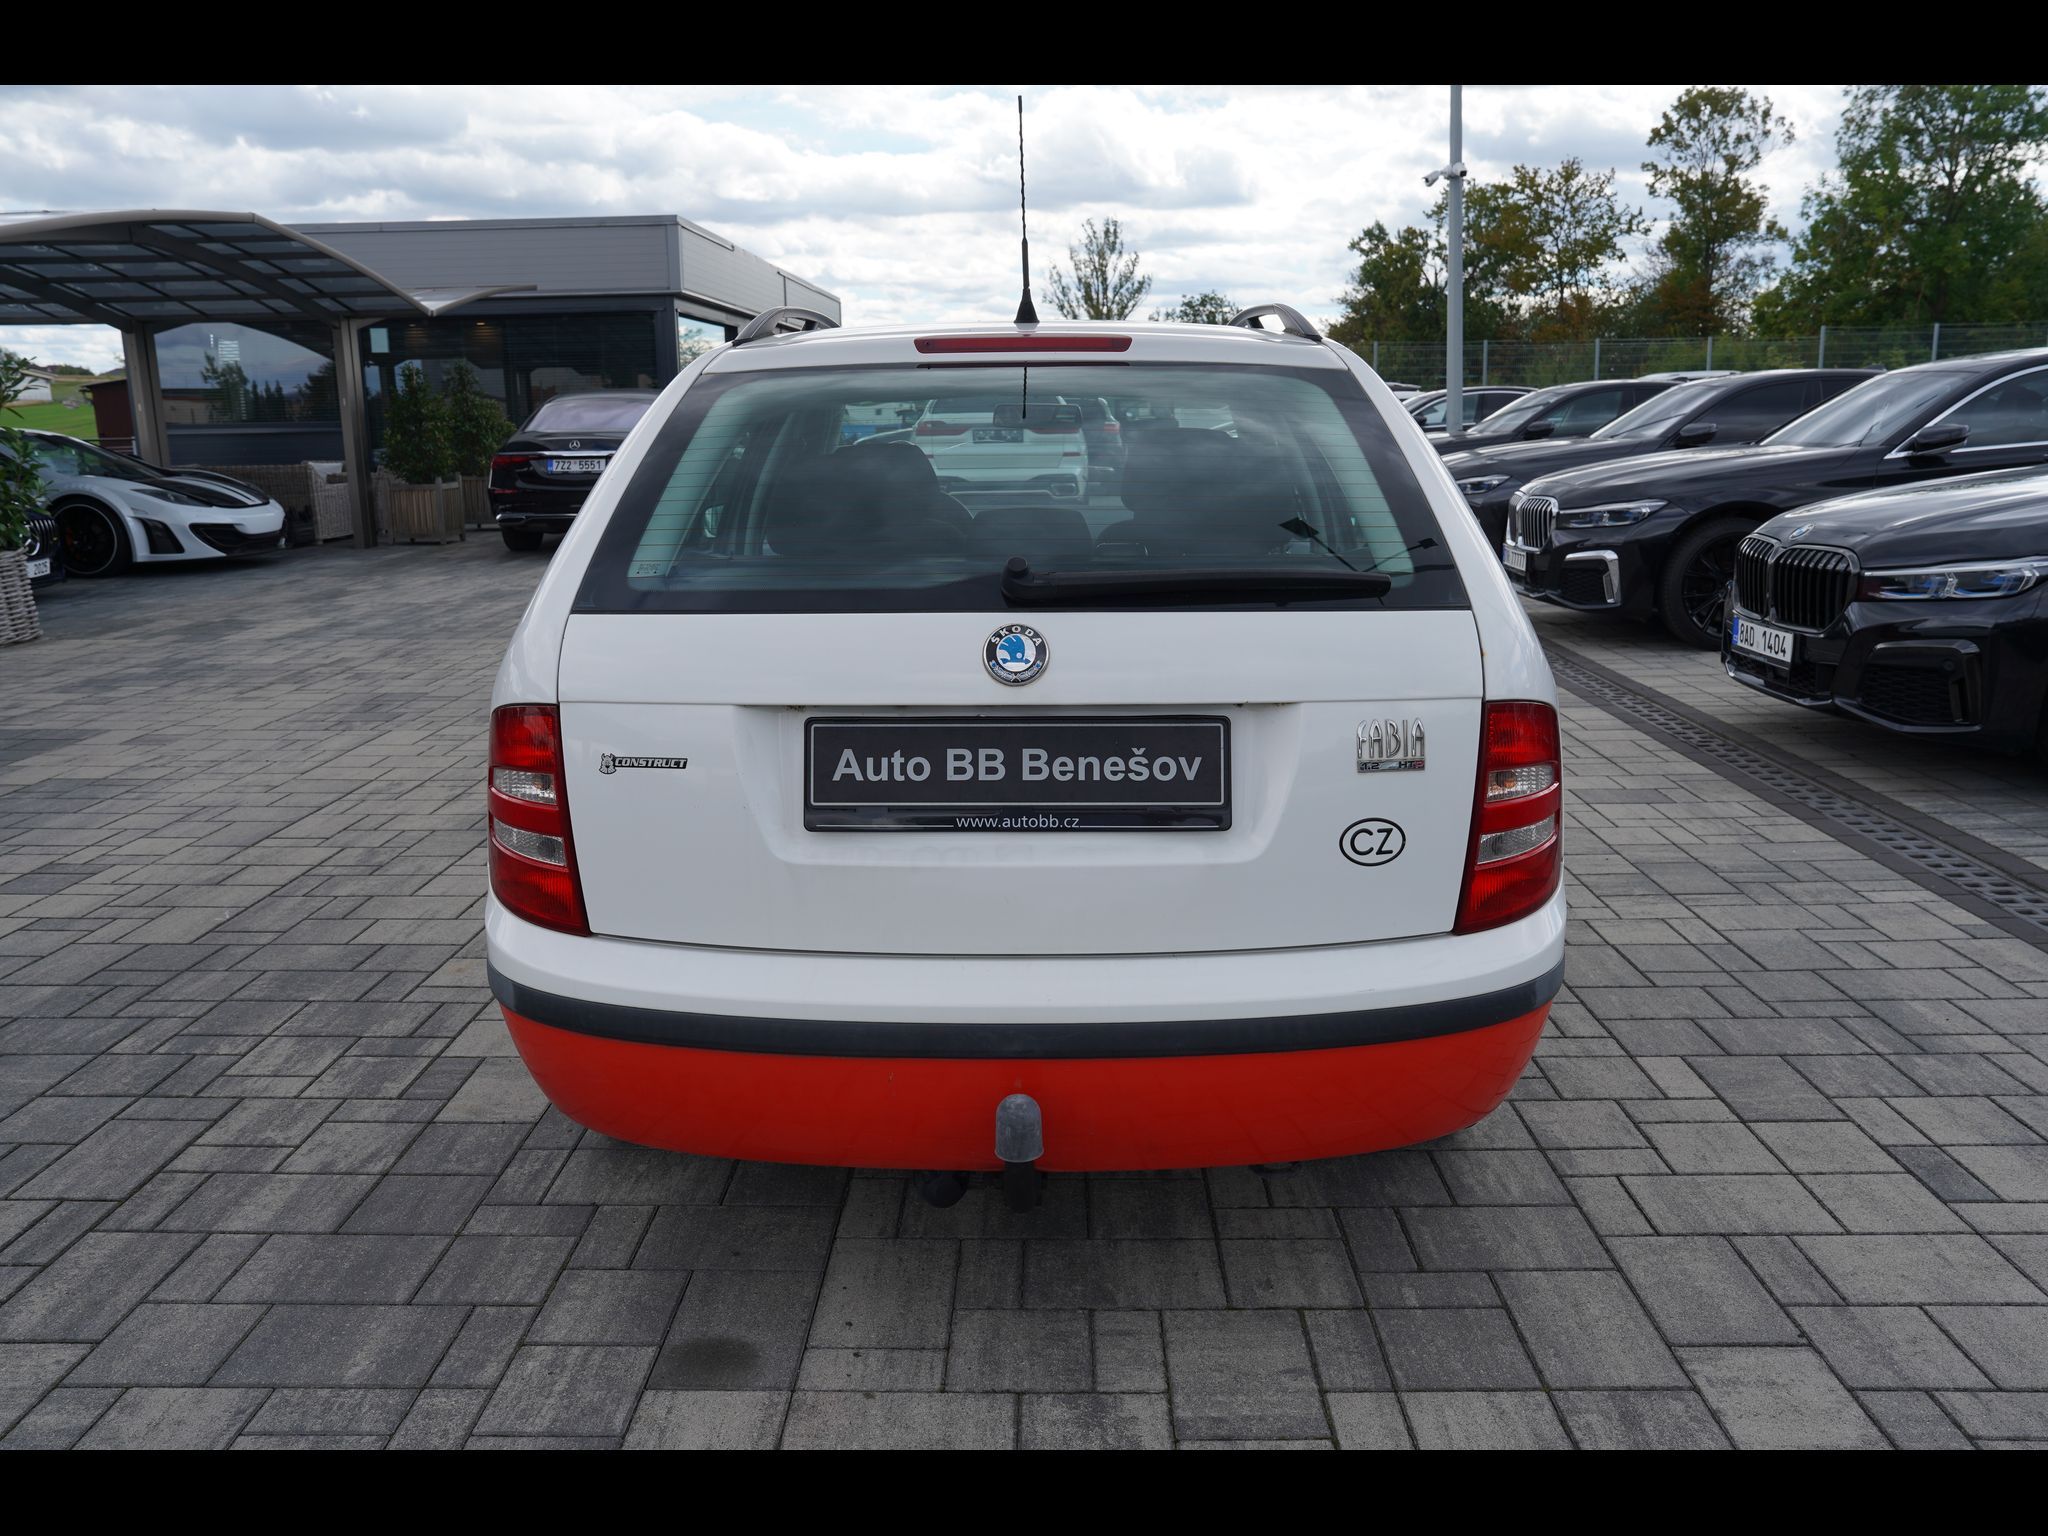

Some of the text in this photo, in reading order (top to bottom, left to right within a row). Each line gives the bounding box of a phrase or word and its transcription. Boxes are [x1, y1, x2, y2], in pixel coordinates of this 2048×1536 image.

[555, 460, 572, 470] 7Z2
[578, 460, 601, 470] 5551
[1739, 623, 1787, 657] 8AD 1404
[1357, 717, 1425, 759] FABIA
[614, 757, 687, 769] CONSTRUCT
[832, 747, 1202, 782] Auto BB Benešov
[1398, 760, 1425, 770] HTP
[956, 813, 1081, 829] www.autobb.cz
[1349, 827, 1394, 856] CZ
